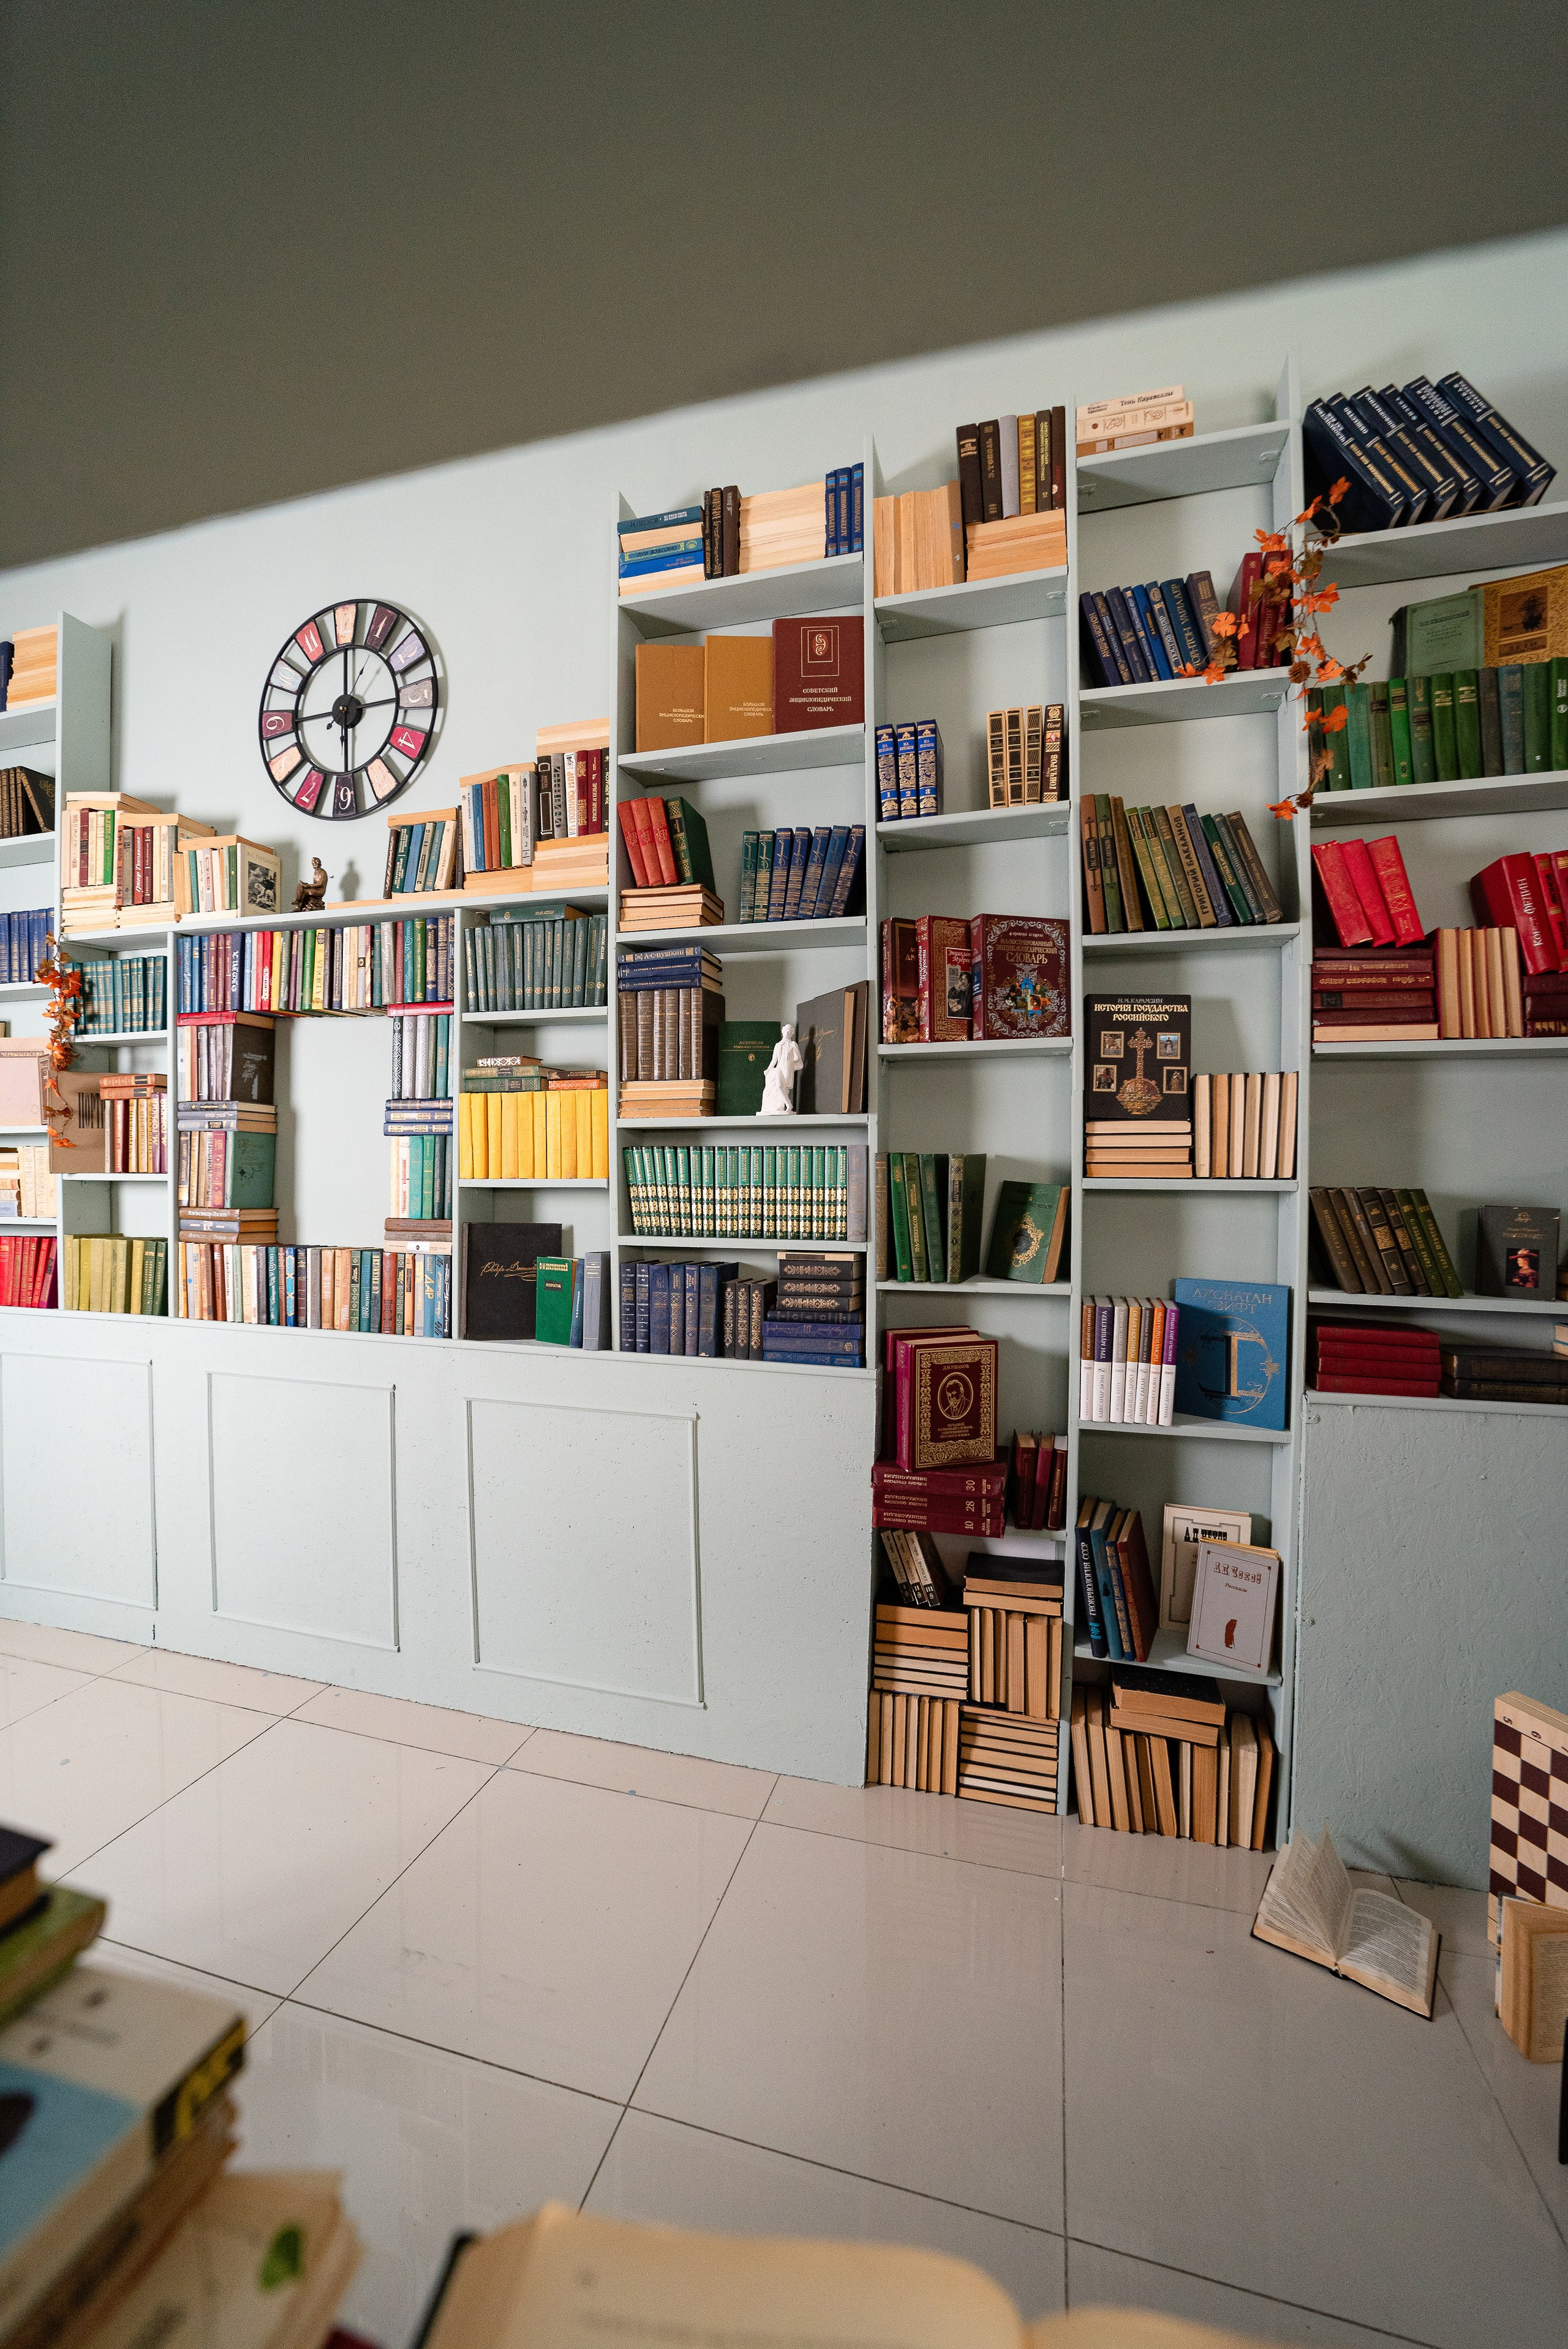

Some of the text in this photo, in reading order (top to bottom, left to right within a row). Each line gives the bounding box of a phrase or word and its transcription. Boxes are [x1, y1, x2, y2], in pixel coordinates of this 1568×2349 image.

[1364, 392, 1396, 429] ИНФОРМАТИКА
[1395, 396, 1418, 421] ФИЗИКА
[1343, 405, 1369, 434] ОБЩЕСТВО
[1170, 582, 1189, 624] УАЙЛДЕР
[374, 616, 387, 638] 1
[1088, 612, 1110, 658] АНДРЕ НОРТОН
[304, 630, 318, 654] 11
[398, 643, 418, 663] 2
[408, 689, 428, 704] 3
[266, 715, 285, 731] 9
[398, 731, 416, 750] 4
[1049, 755, 1058, 789] ГОНЧАРОВ
[339, 786, 350, 810] 6
[1173, 816, 1209, 914] ГРИГОРИЙ БАКЛАНОВ
[996, 945, 1057, 954] ЭНЦИКЛОПЕДИЧЕСКИЙ
[1006, 952, 1048, 963] СЛОВАРЬ
[1094, 1003, 1188, 1013] ИСТОРИЯ ГОСУДАРСТВА
[1112, 1013, 1169, 1022] РОССИЙСКОГО
[1192, 1288, 1272, 1303] ДЖОНАТАН
[1207, 1300, 1257, 1314] СВИФТ
[966, 1480, 975, 1491] 30
[966, 1501, 974, 1512] 28
[965, 1521, 973, 1529] 10
[1084, 1562, 1096, 1615] ГЕОКРИОЛОГИЯ
[1225, 1583, 1248, 1593] Рассказы
[1503, 1716, 1513, 1725] 5
